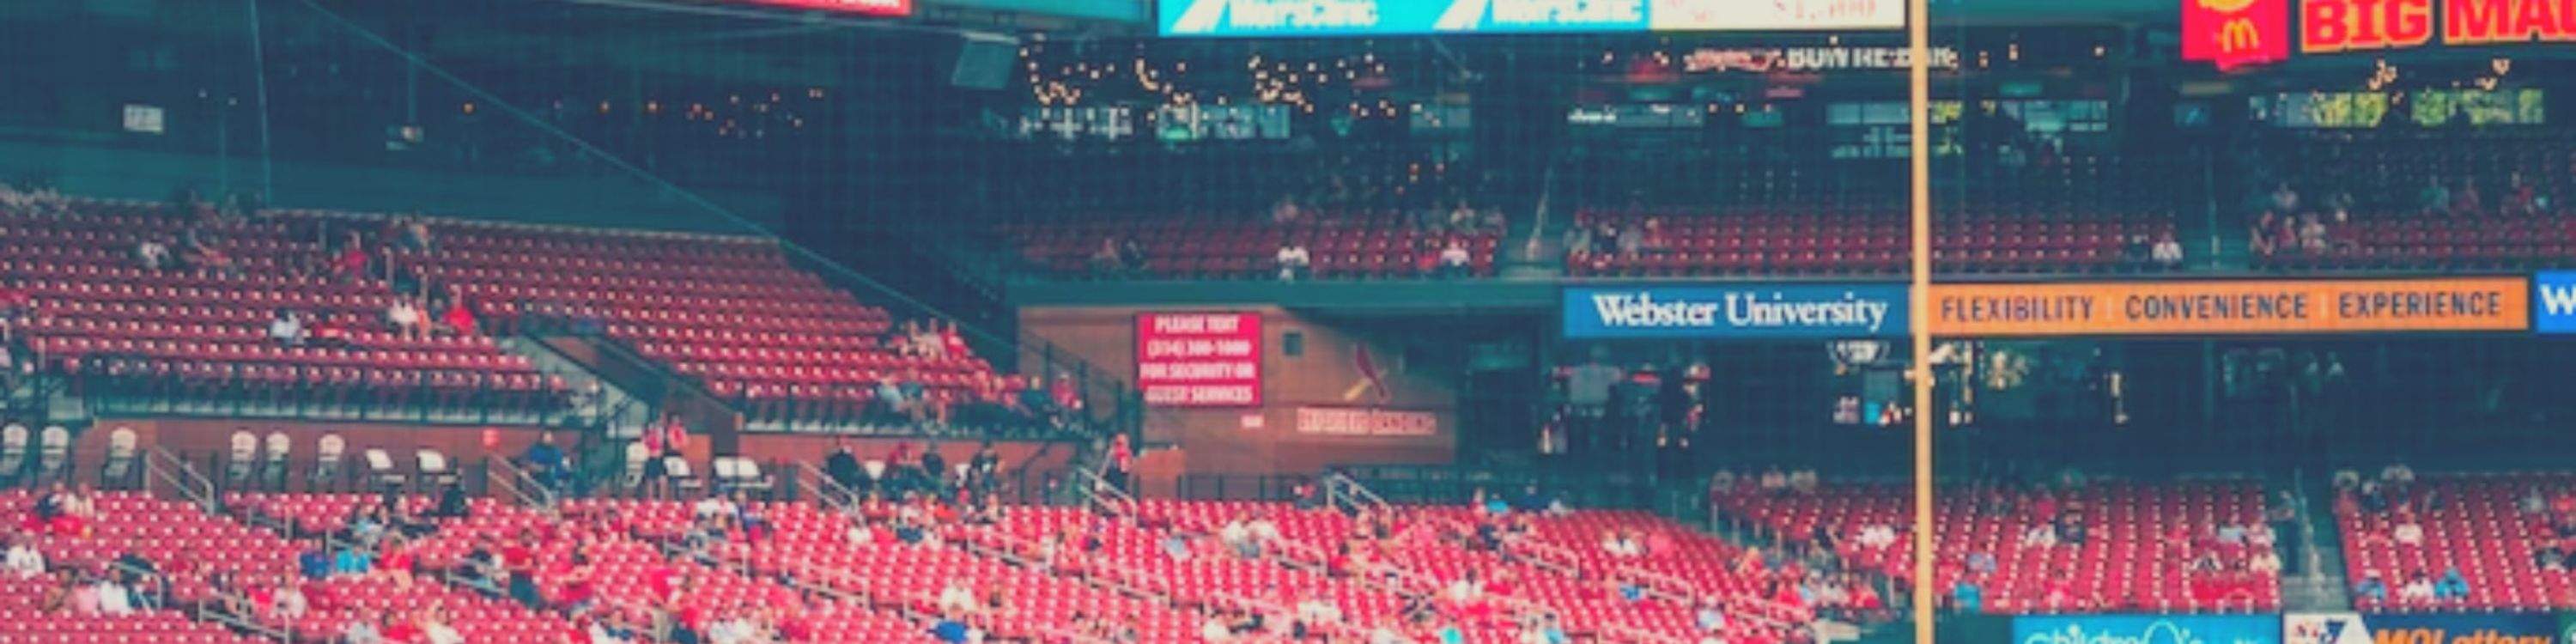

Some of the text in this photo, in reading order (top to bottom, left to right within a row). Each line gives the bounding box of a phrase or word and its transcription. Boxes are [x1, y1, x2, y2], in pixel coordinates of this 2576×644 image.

[2300, 0, 2434, 52] BIG
[1593, 292, 1887, 333] Webster University
[1941, 291, 2502, 321] FLEXIBILITY CONVENIENCE EXPERIENCE
